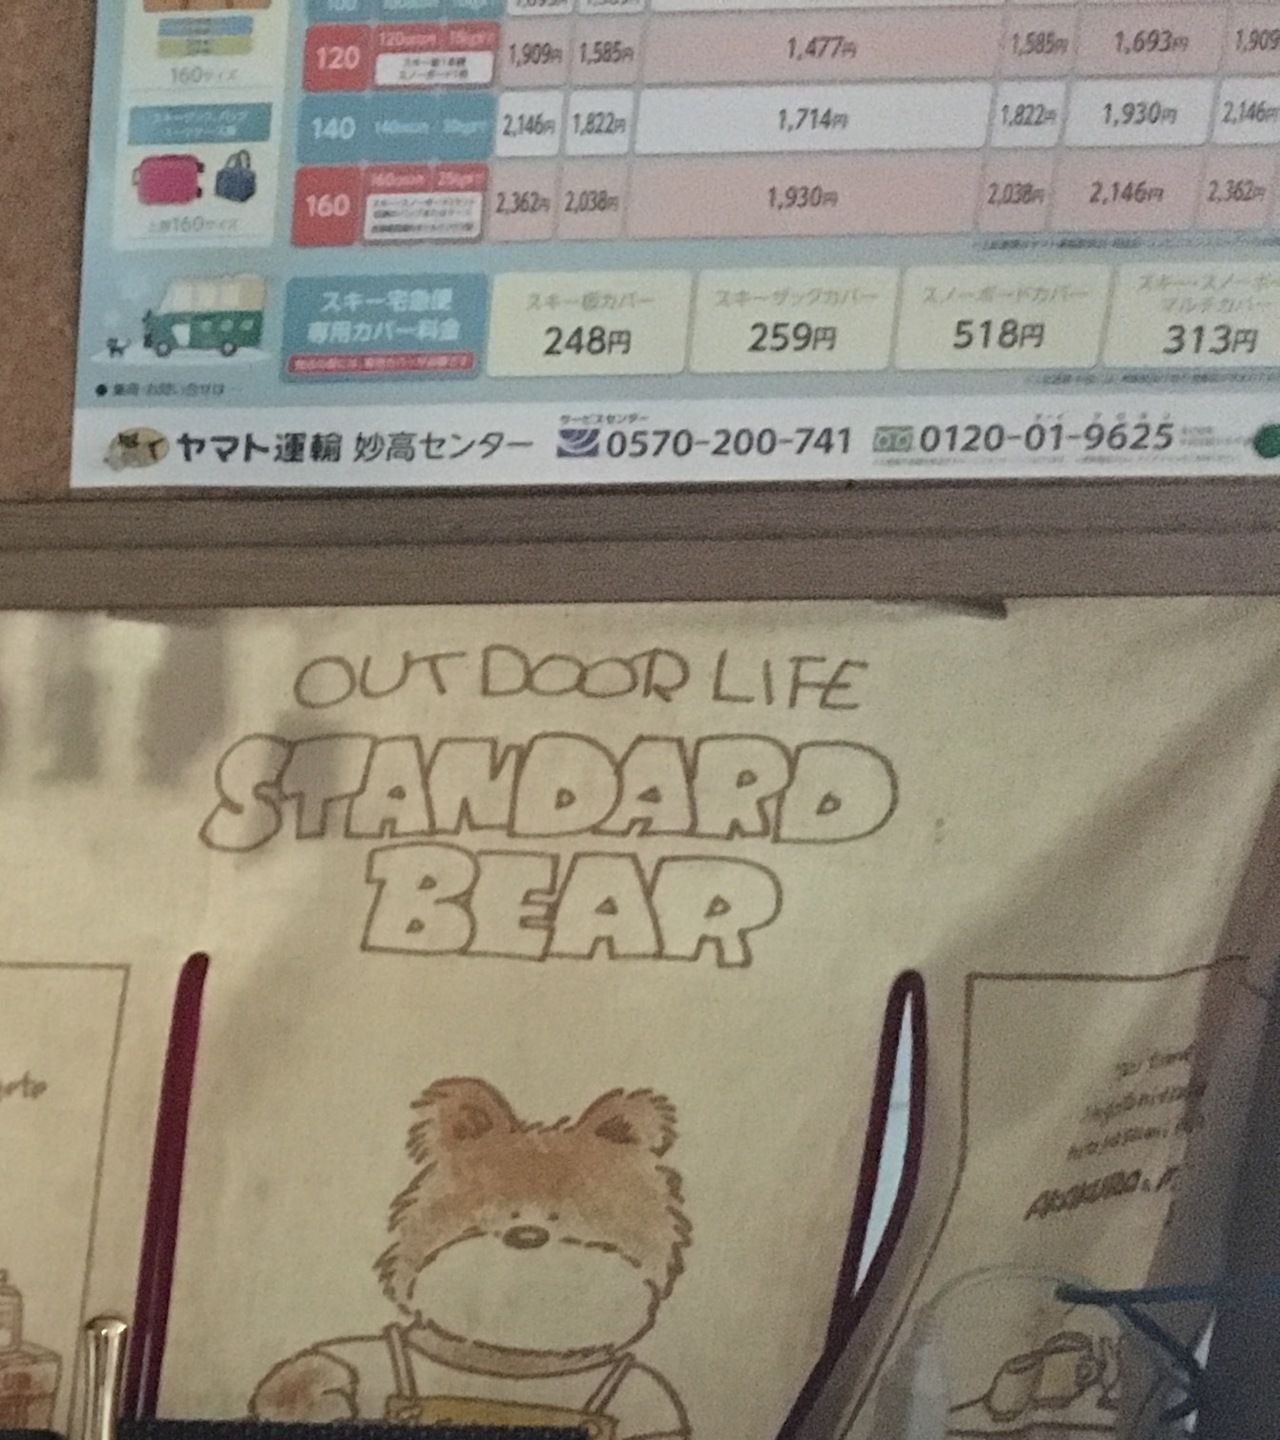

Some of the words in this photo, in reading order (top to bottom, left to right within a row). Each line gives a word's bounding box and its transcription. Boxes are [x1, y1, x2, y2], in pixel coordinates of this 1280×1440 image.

[580, 41, 634, 66] 1,585円
[787, 36, 856, 60] 1,477円
[1115, 29, 1189, 55] 1,693円
[316, 46, 360, 70] 120
[510, 43, 562, 67] 1,909円
[503, 113, 555, 138] 2,146円
[573, 112, 626, 136] 1,822円
[778, 108, 848, 132] 1,714円
[1104, 101, 1178, 128] 1,930円
[312, 116, 356, 140] 140
[496, 191, 550, 215] 2,362円
[564, 190, 619, 214] 2,038円
[768, 186, 839, 210] 1,930円
[1090, 180, 1164, 205] 2,146円
[1207, 179, 1266, 203] 2,362円
[305, 193, 350, 217] 160
[544, 325, 632, 355] 248円
[747, 322, 837, 352] 259円
[953, 318, 1046, 349] 518円
[1163, 324, 1259, 355] 313円
[177, 431, 343, 463] ヤマト運輸
[354, 430, 534, 462] 妙高センター
[606, 427, 851, 457] 0570-200-741
[920, 423, 1174, 452] 0120-01-9625
[712, 649, 870, 711] LIFE
[199, 732, 898, 852] STANDARD
[361, 843, 783, 968] BEAR
